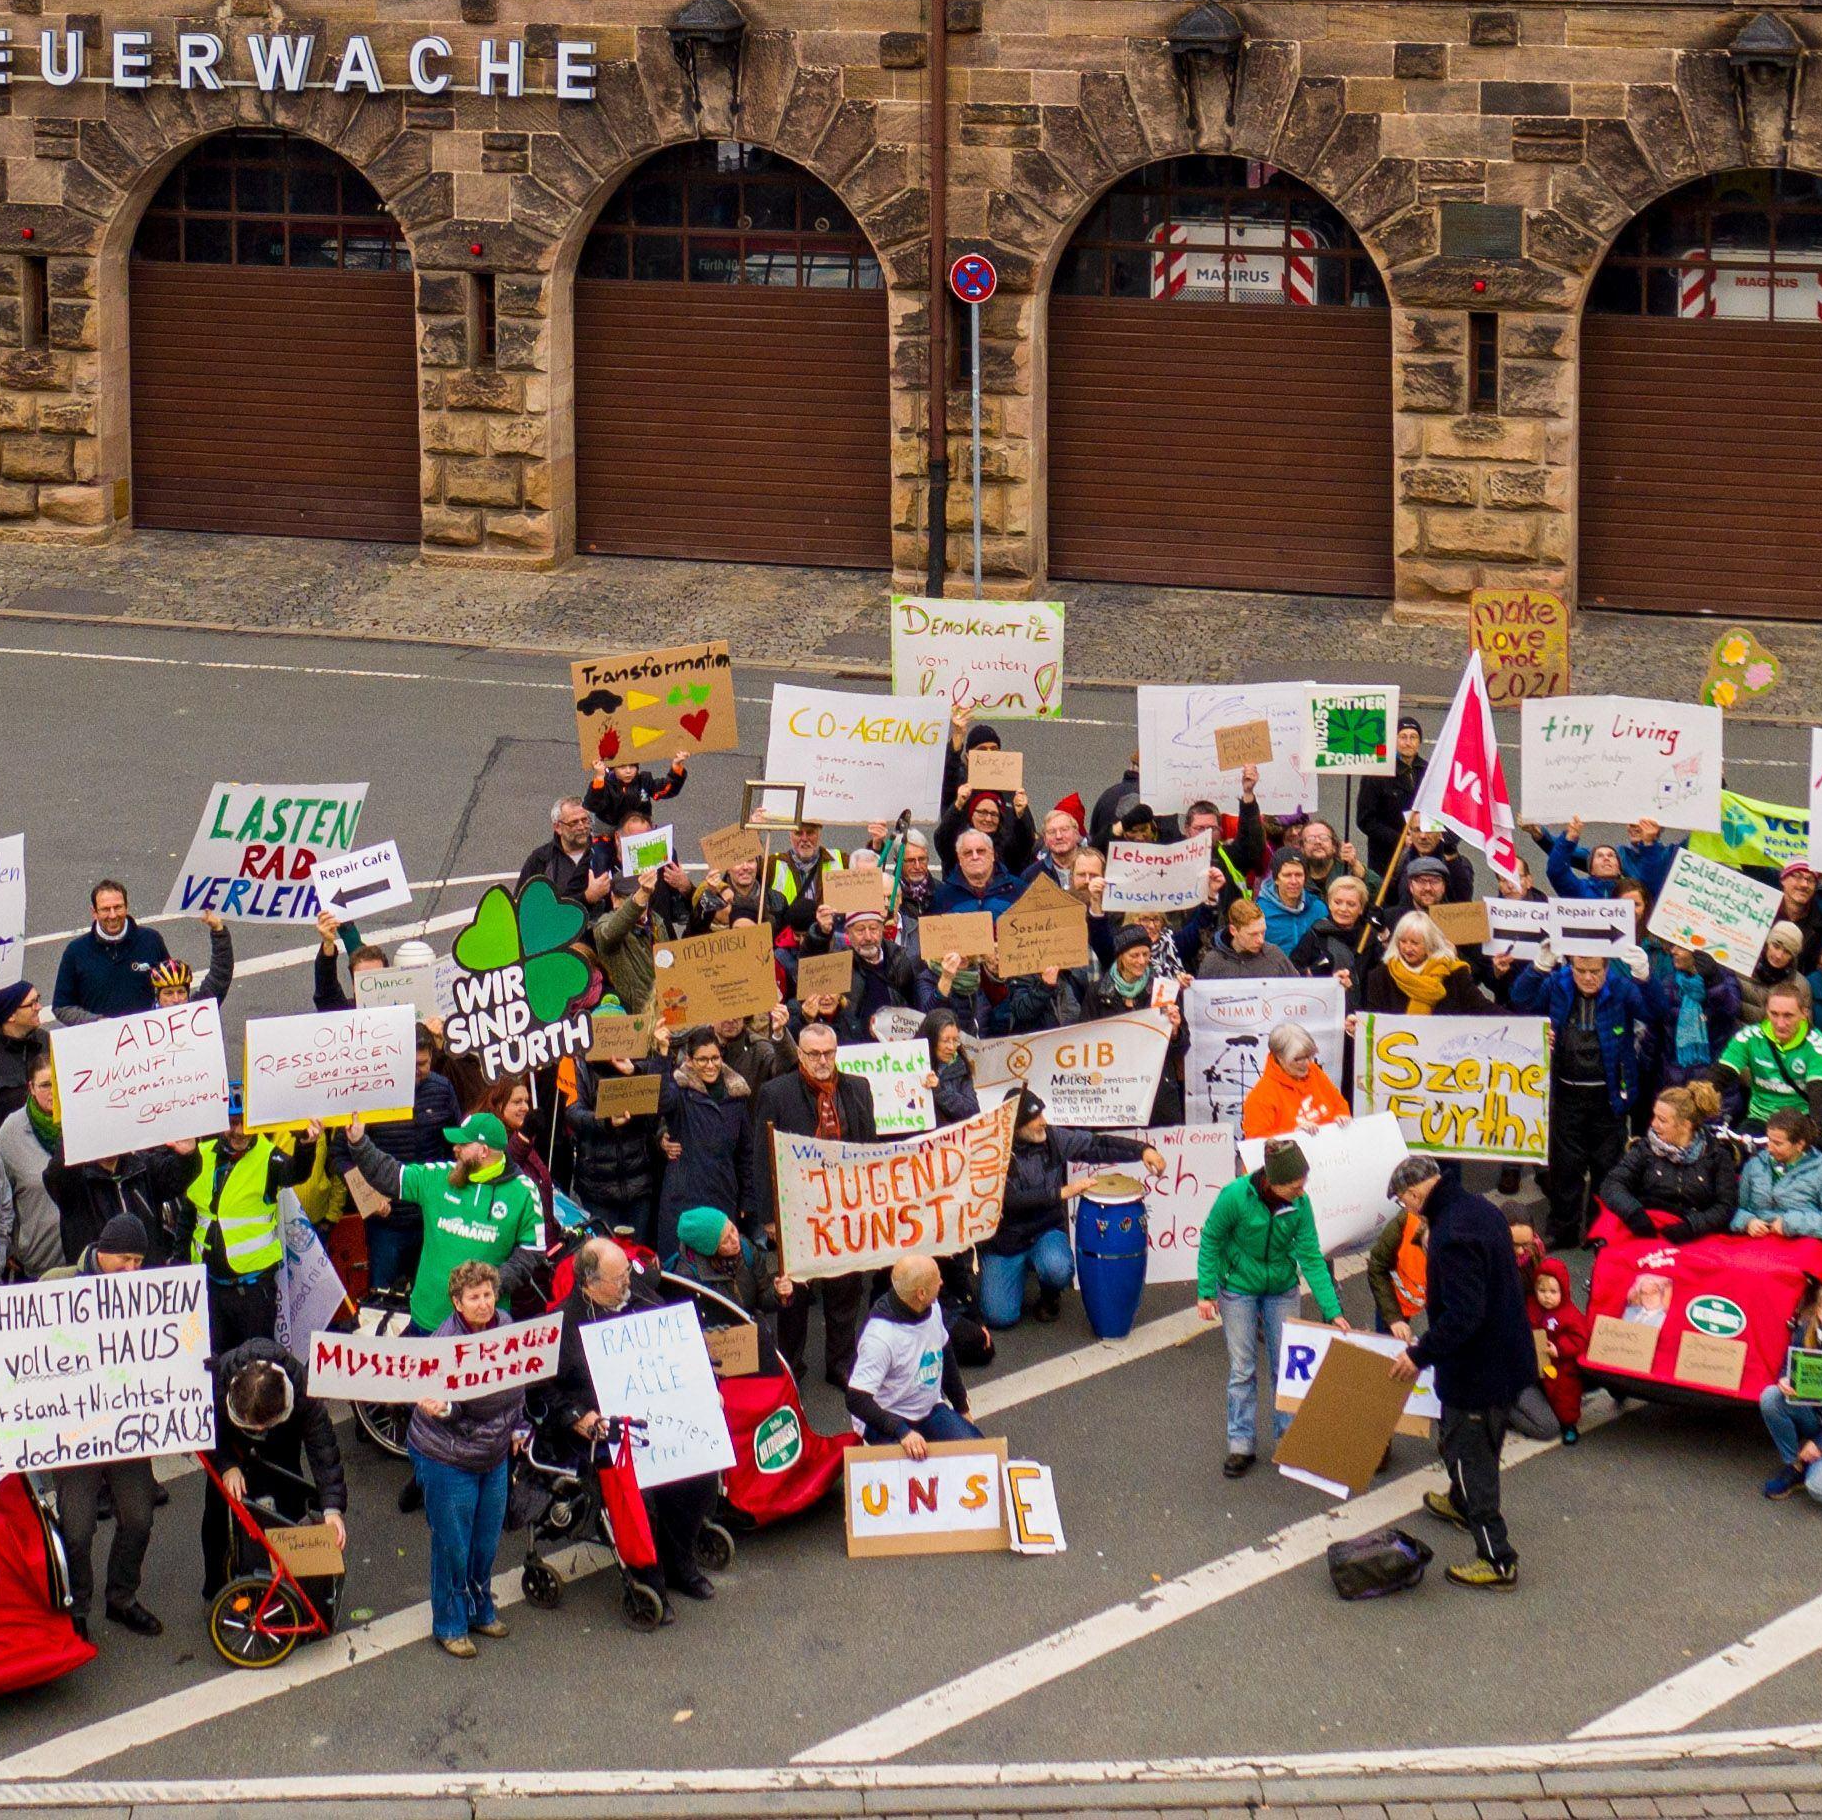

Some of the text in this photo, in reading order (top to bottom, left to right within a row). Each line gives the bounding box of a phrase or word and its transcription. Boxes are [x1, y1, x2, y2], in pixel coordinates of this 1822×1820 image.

[1197, 268, 1270, 283] MAGIRUS
[1736, 277, 1798, 289] MAGRUS
[581, 646, 730, 687] Transformation
[1499, 650, 1540, 668] not
[1317, 695, 1386, 711] FÜRTHER
[789, 707, 942, 745] CO-AGEING
[1541, 715, 1594, 746] tiny
[1324, 752, 1378, 767] FORUM
[210, 794, 363, 851] LASTEN
[239, 845, 317, 881] RAD
[319, 848, 392, 883] Repair Café
[1107, 882, 1200, 902] Tauschregal
[1490, 906, 1527, 921] Repair
[1557, 903, 1627, 921] Repair Café
[360, 975, 413, 993] Chance
[456, 965, 526, 1015] WIR
[446, 1000, 531, 1055] SIND
[1217, 1006, 1256, 1018] NIMM
[1284, 1004, 1308, 1017] GIB
[114, 1005, 216, 1056] ADFC
[313, 1016, 396, 1049] adfc
[482, 1013, 591, 1081] FÜRTH
[72, 1046, 195, 1094] ZUKUNFT
[1055, 1042, 1116, 1069] GIB
[1376, 1031, 1545, 1097] Szene
[107, 1069, 211, 1108] gemeinsam
[325, 1077, 396, 1100] nutzen
[1052, 1086, 1120, 1097] Gartenstraße 14
[1052, 1095, 1103, 1105] 90762 Fürth
[1163, 1128, 1228, 1146] will einen
[1387, 1091, 1527, 1150] Fürth
[791, 1144, 823, 1161] Wir
[808, 1146, 965, 1214] JUGEND
[806, 1194, 954, 1257] KUNST
[95, 1278, 201, 1321] HANDELN
[4, 1322, 179, 1379] vollen HAUS
[89, 1376, 203, 1413] Nichtstun
[625, 1364, 686, 1401] ALLE
[15, 1433, 71, 1469] doch
[75, 1436, 113, 1461] ein
[114, 1404, 214, 1454] GRAUS
